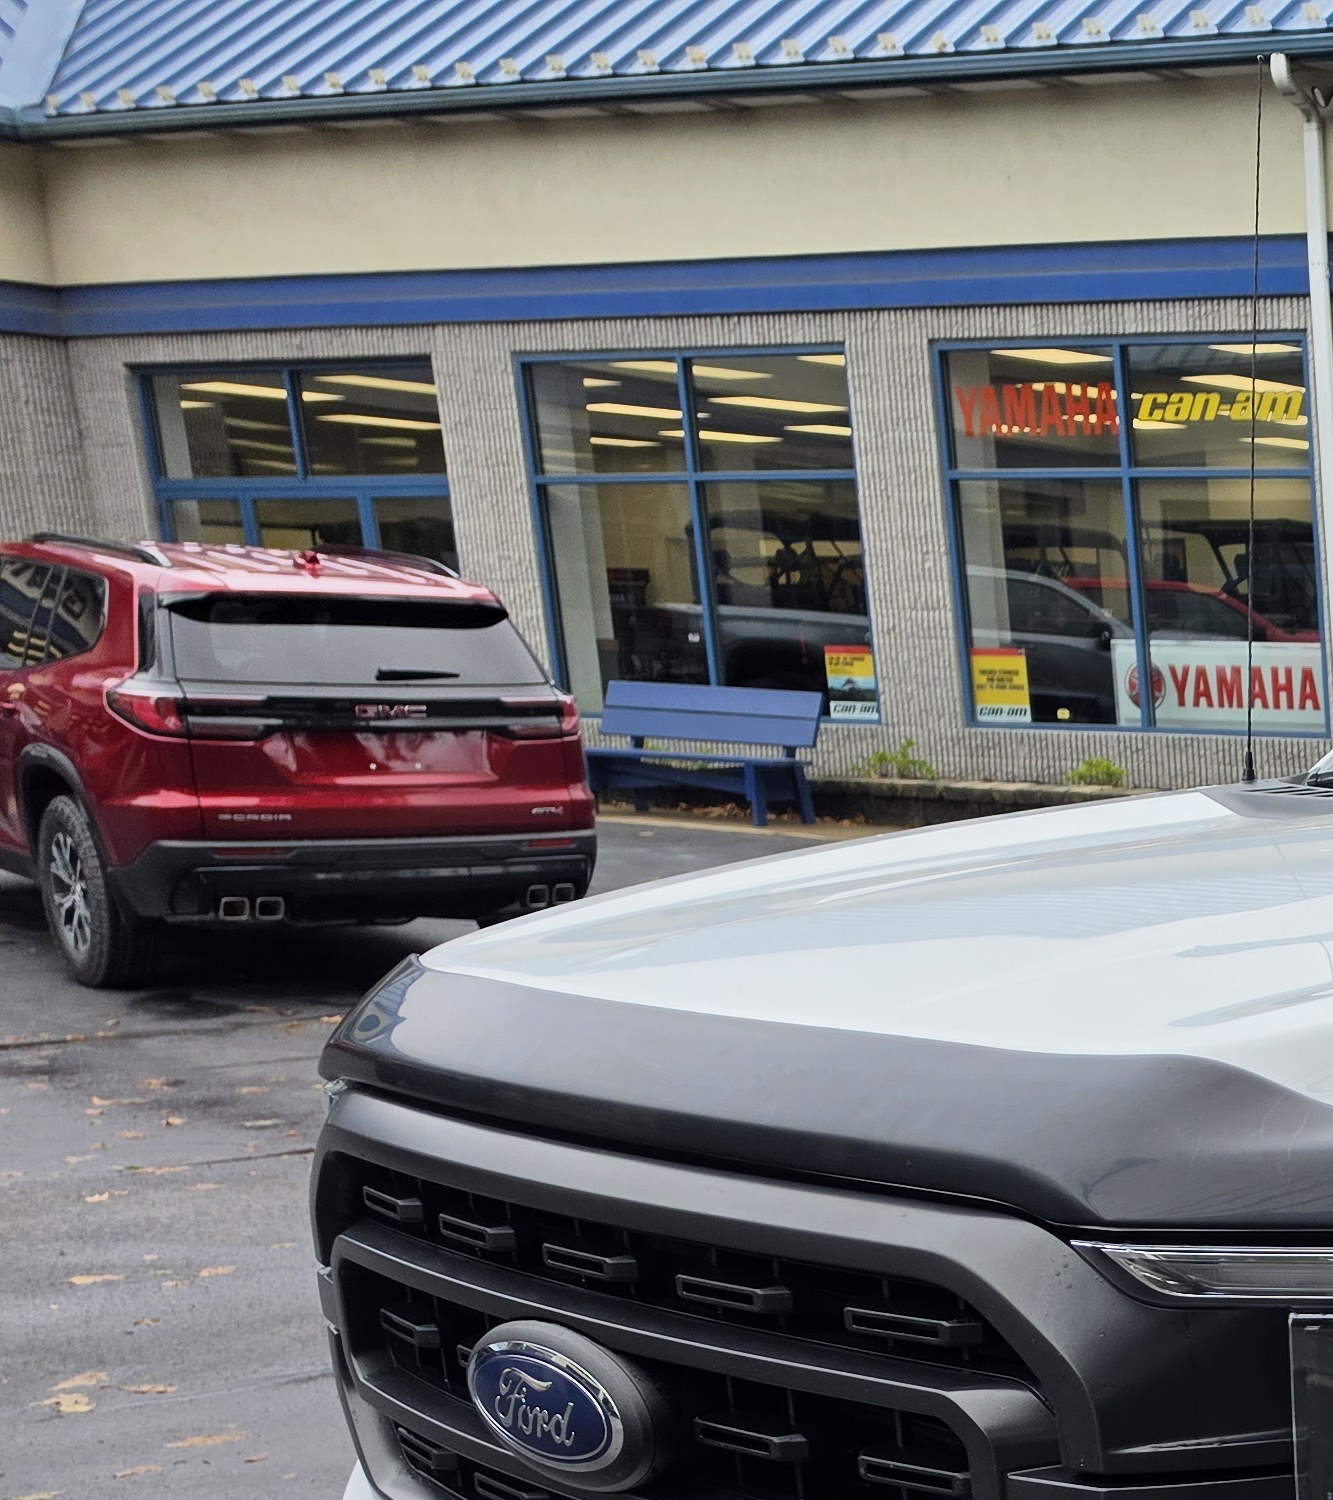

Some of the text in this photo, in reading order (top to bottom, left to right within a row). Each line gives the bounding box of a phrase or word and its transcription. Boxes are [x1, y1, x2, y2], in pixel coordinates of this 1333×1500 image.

[954, 381, 1120, 438] YAMAHA
[1138, 390, 1304, 423] can-am
[354, 703, 428, 719] GMC
[1168, 663, 1322, 711] YAMAHA
[495, 1366, 576, 1448] Ford
